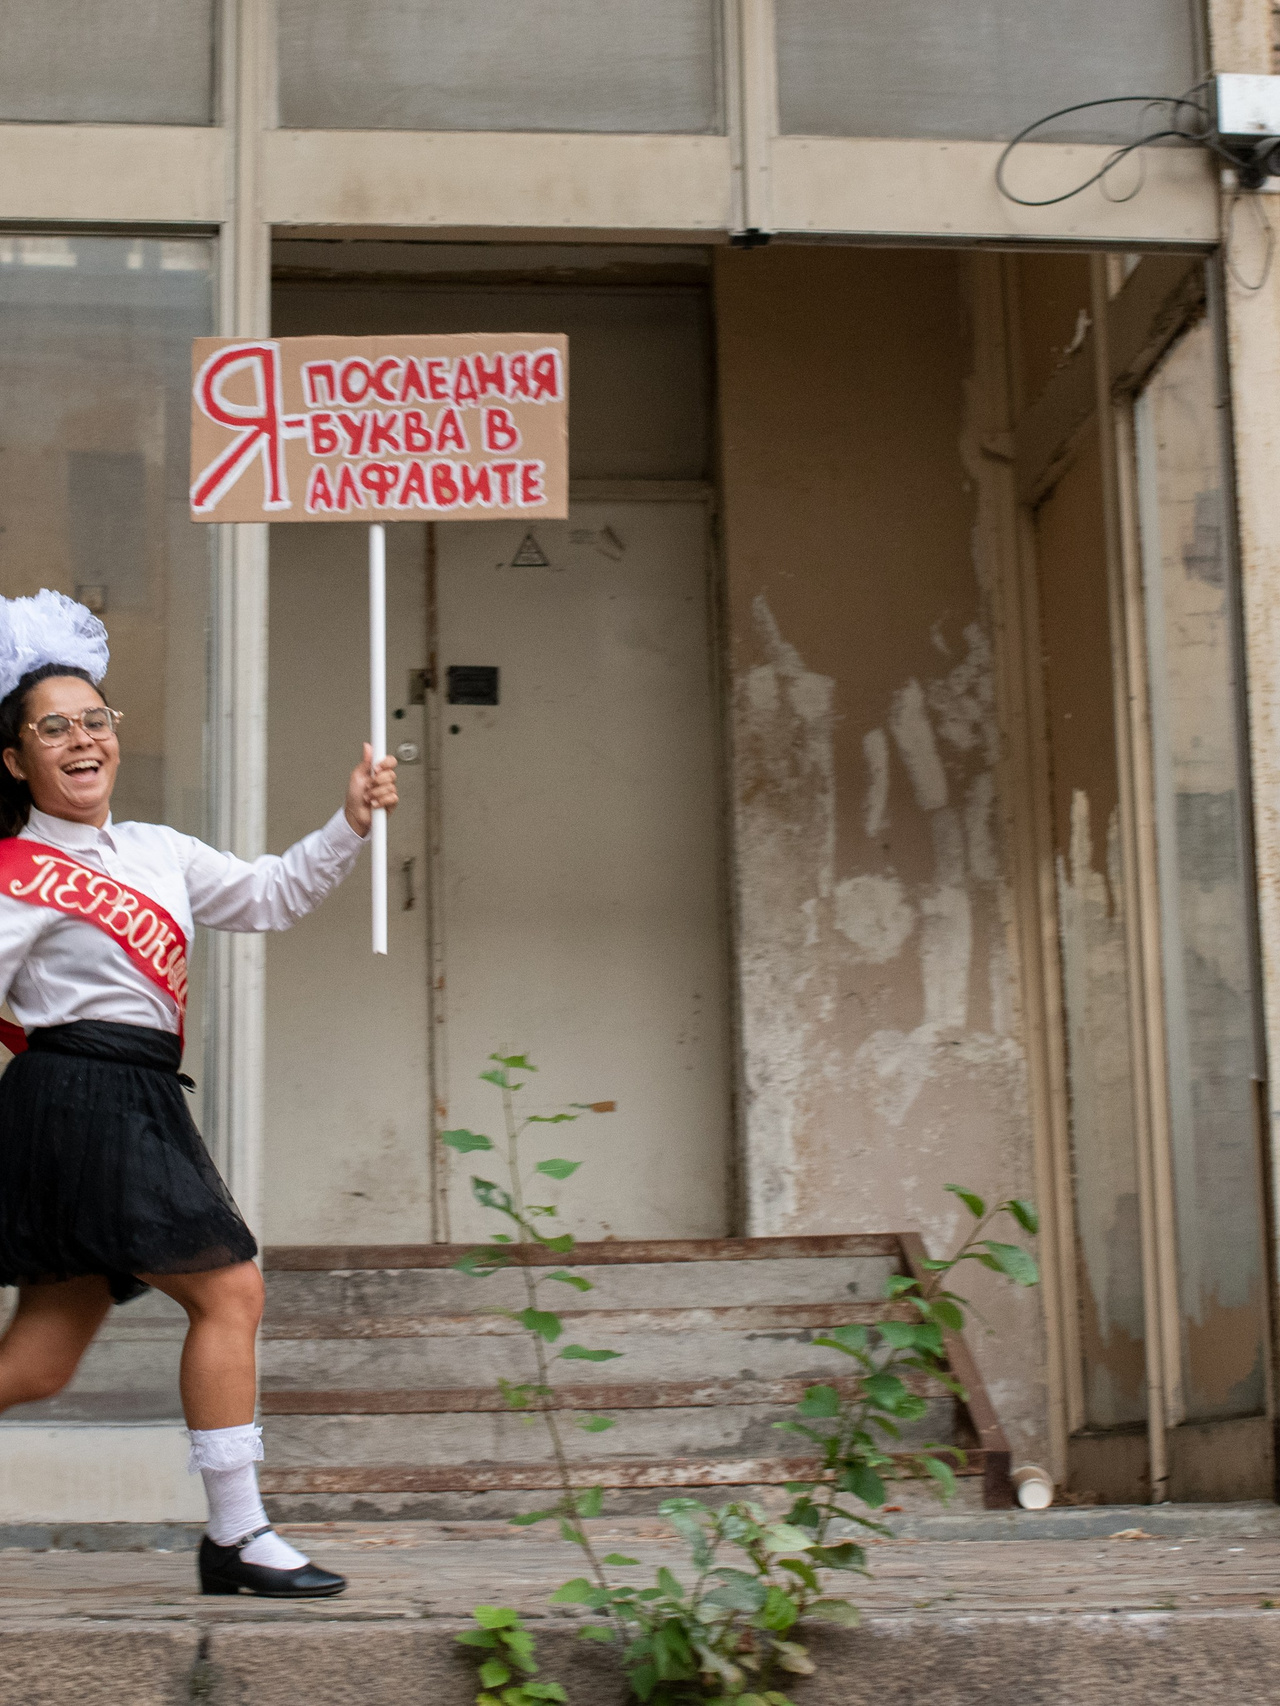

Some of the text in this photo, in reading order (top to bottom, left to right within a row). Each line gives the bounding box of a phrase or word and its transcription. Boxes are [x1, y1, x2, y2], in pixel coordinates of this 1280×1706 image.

[306, 352, 559, 405] ПОСЛЕДНЯЯ
[310, 407, 520, 456] БУКВА В
[309, 461, 544, 511] АЛФАВИТЕ
